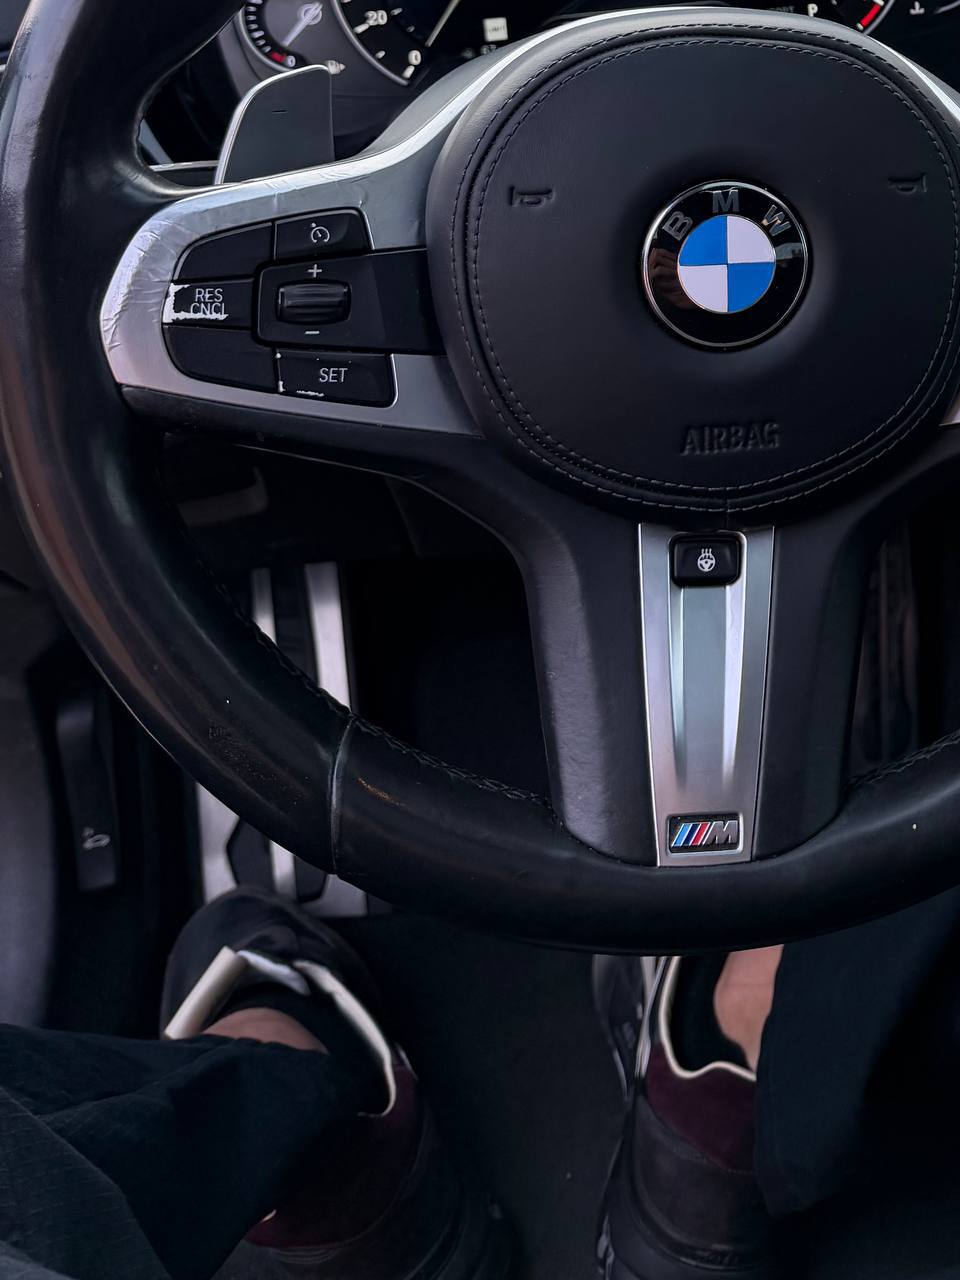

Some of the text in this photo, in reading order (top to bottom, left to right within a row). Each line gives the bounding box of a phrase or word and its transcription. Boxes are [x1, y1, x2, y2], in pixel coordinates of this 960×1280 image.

[365, 10, 388, 26] 20
[807, 3, 818, 17] P
[408, 50, 421, 65] 0
[662, 189, 791, 241] BMW
[195, 288, 223, 302] RES
[319, 367, 348, 383] SET
[680, 423, 780, 456] AIRBAG
